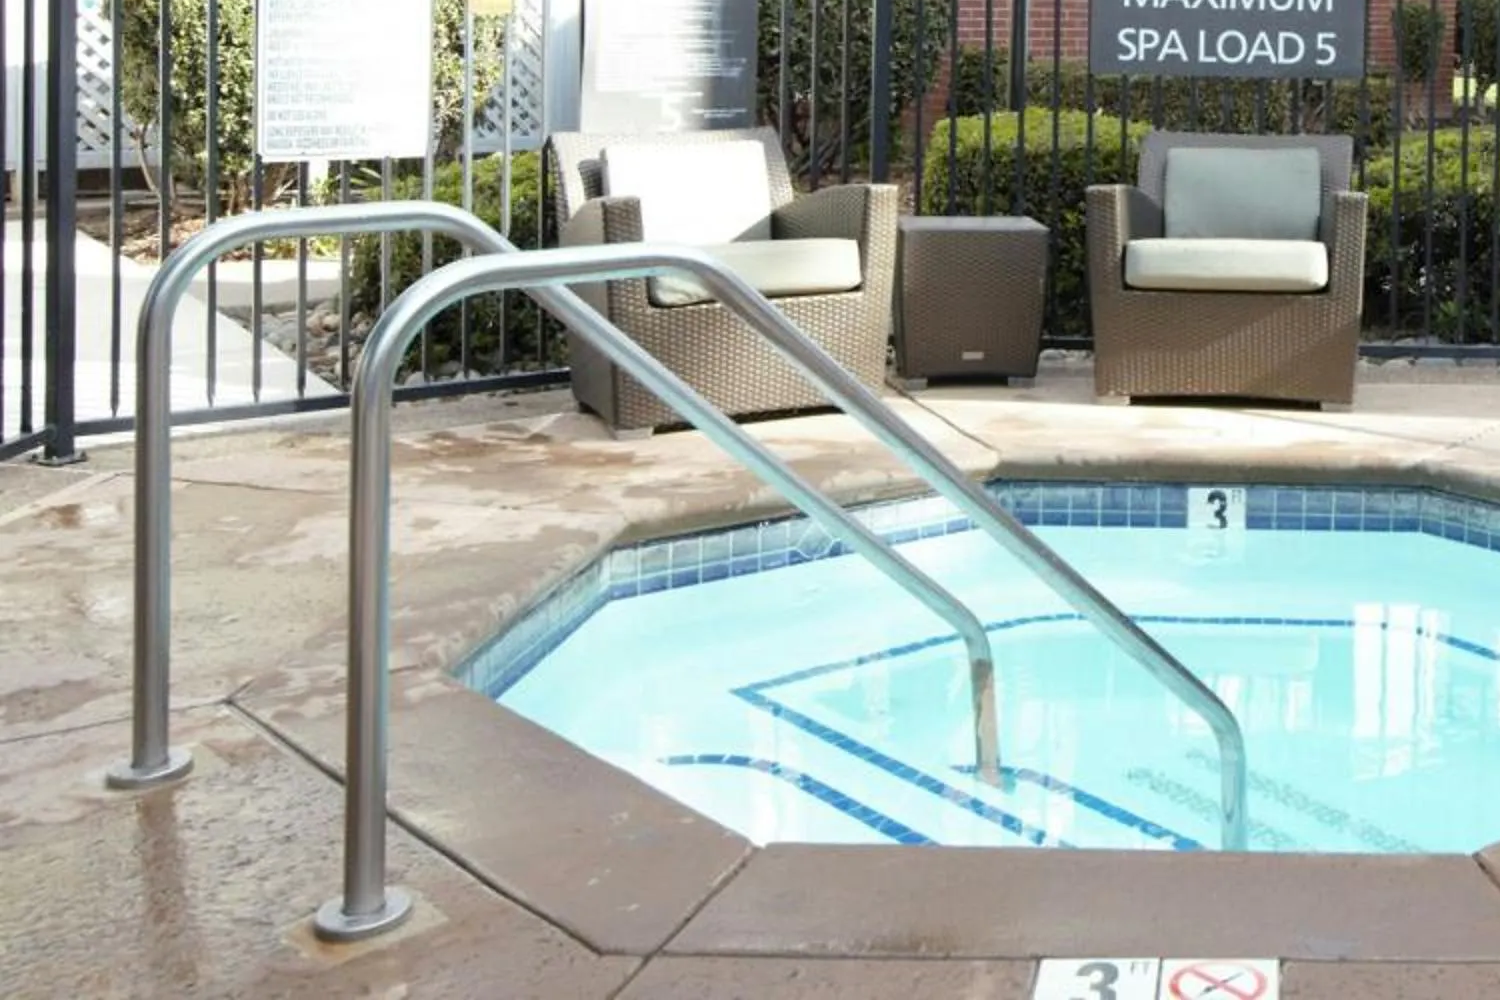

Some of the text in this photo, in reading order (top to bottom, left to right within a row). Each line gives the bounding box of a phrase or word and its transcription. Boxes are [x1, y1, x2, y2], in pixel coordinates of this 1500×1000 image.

[1117, 28, 1337, 65] SPA LOAD 5
[1206, 490, 1228, 529] 3
